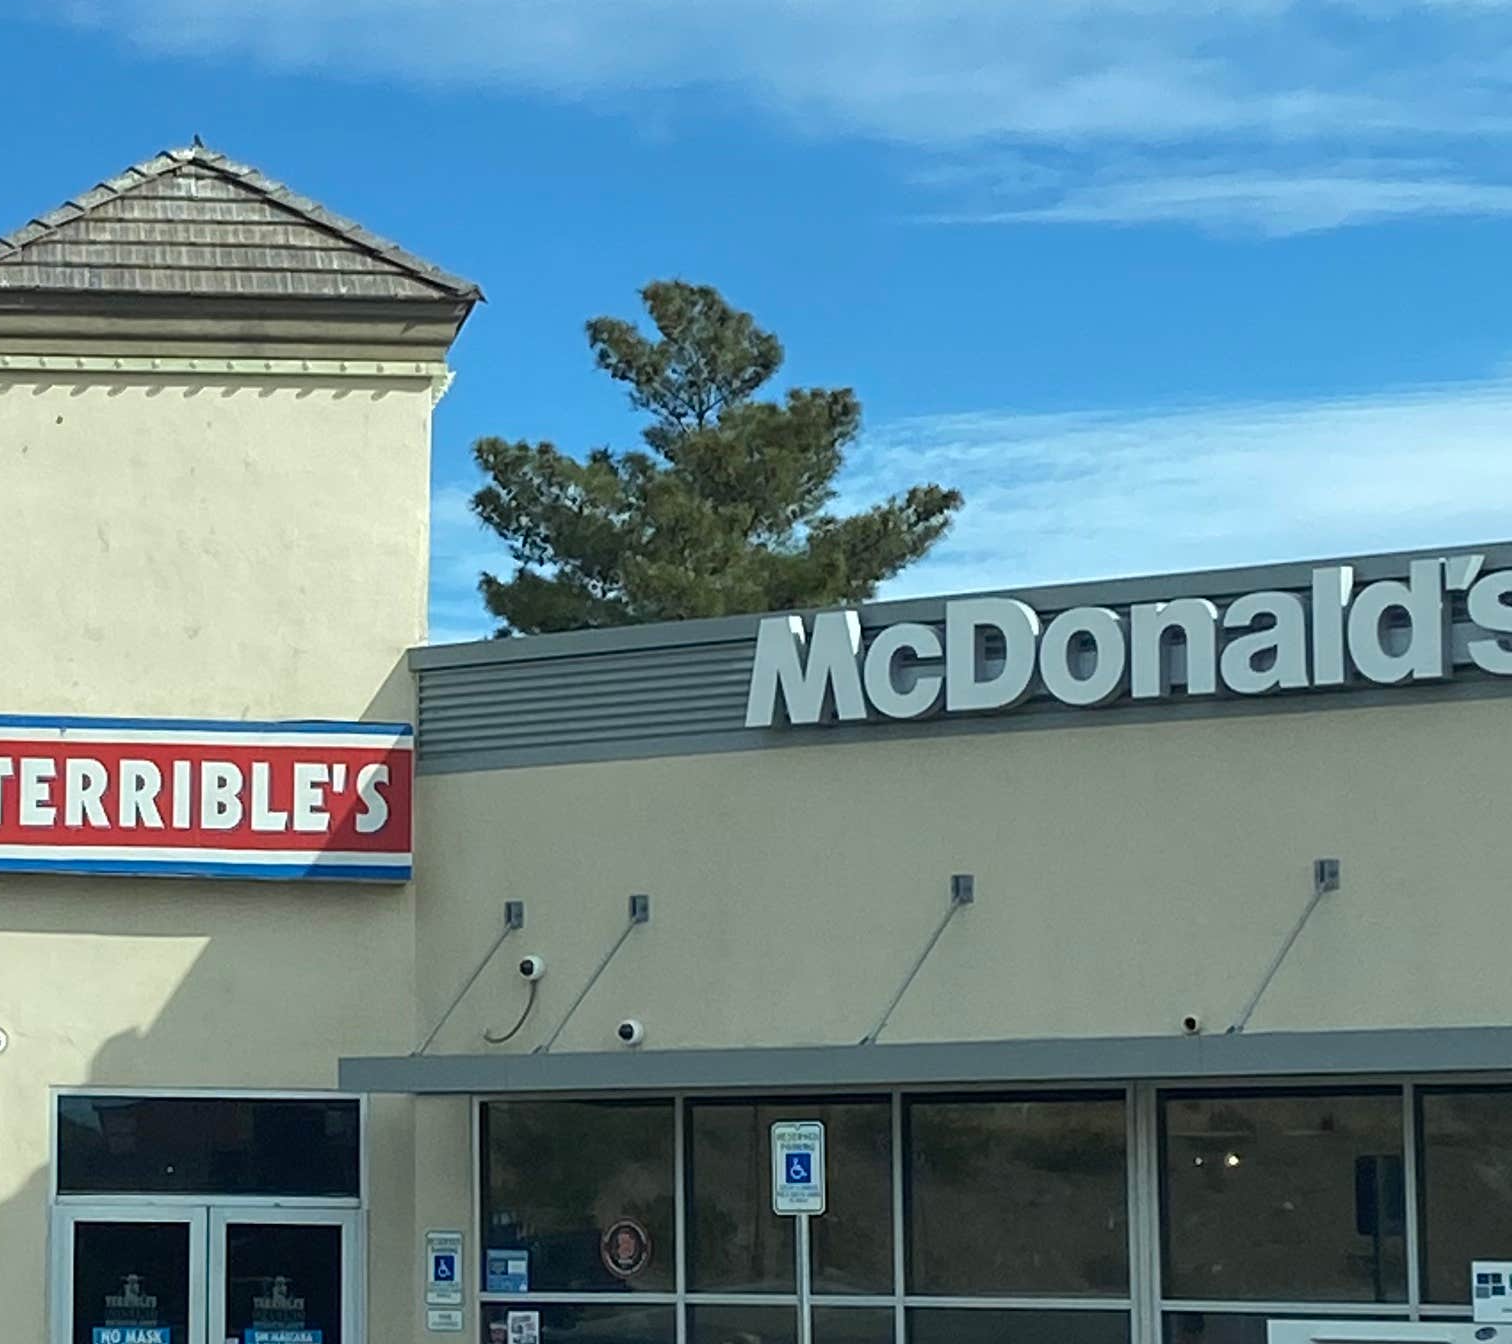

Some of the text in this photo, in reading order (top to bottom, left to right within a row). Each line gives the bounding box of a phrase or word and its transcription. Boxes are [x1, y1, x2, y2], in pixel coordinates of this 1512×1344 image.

[744, 554, 1512, 728] McDonald's
[101, 1328, 162, 1344] NO MASK
